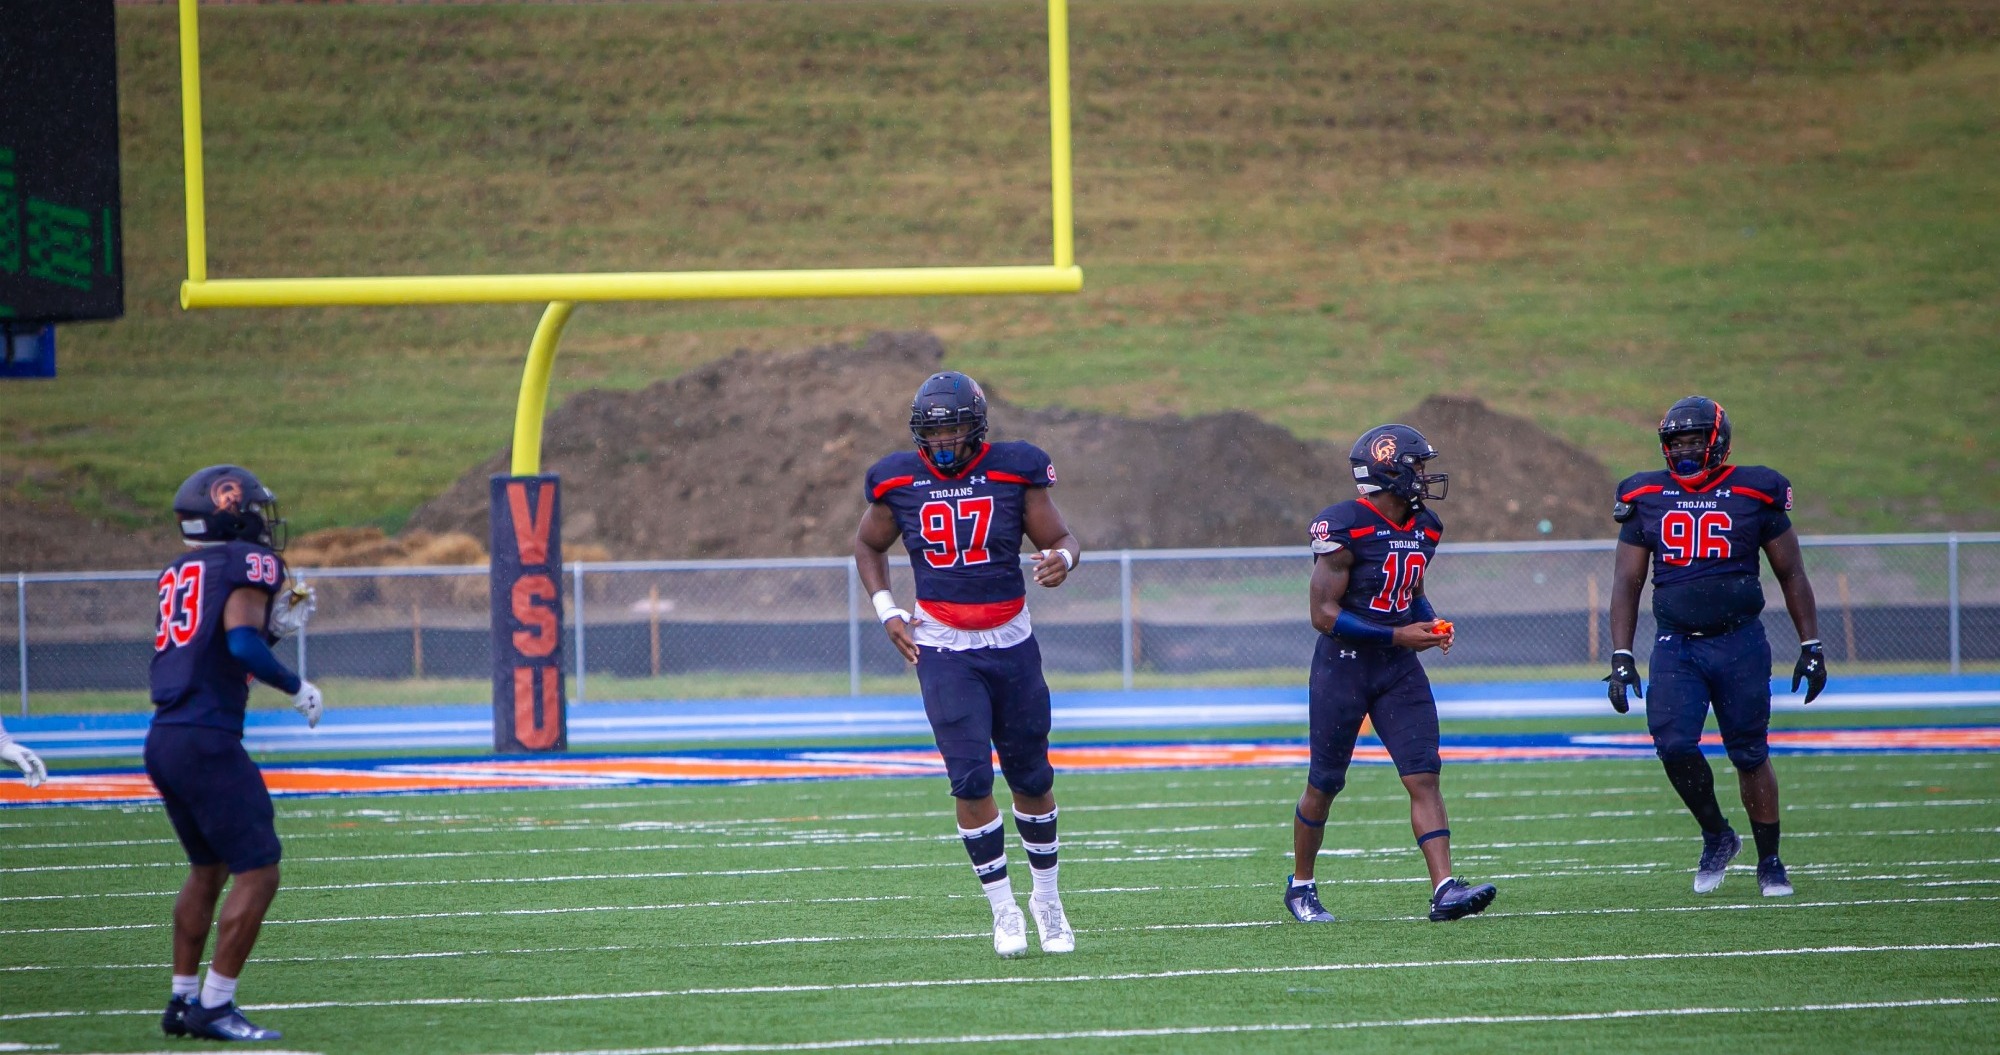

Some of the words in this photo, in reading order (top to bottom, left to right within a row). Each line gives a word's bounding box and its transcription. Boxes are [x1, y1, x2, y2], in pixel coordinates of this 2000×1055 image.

[929, 487, 973, 499] TROJANS
[1676, 501, 1718, 509] TROJANS
[919, 496, 995, 569] 97
[1388, 540, 1420, 549] TROJANS
[1660, 510, 1733, 567] 96
[245, 552, 278, 585] 33
[1369, 551, 1428, 613] 10
[155, 560, 206, 652] 33
[505, 482, 560, 750] VSU
